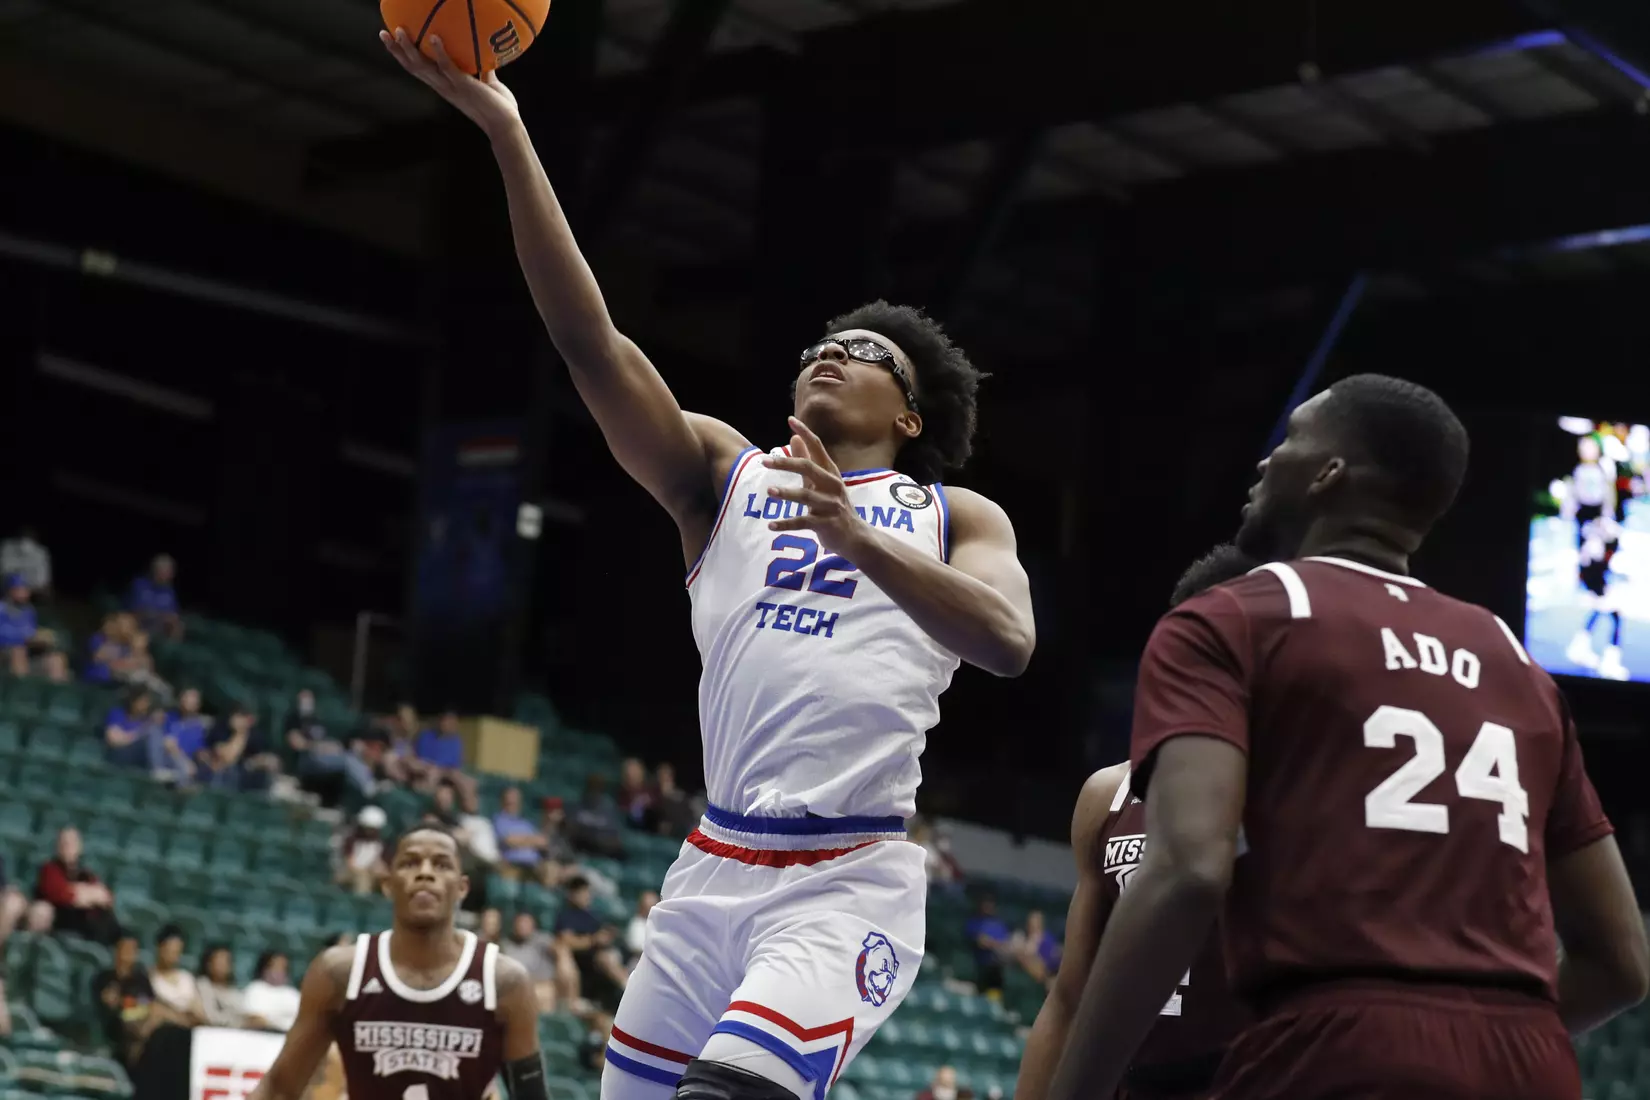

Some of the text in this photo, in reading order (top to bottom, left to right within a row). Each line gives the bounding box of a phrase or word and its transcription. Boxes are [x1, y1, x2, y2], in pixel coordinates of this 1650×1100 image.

[764, 533, 858, 599] 22
[755, 602, 839, 638] TECH
[1381, 627, 1481, 689] ADO
[1363, 705, 1529, 854] 24
[354, 1024, 482, 1054] MISSISSIPPI
[388, 1053, 444, 1073] STATE
